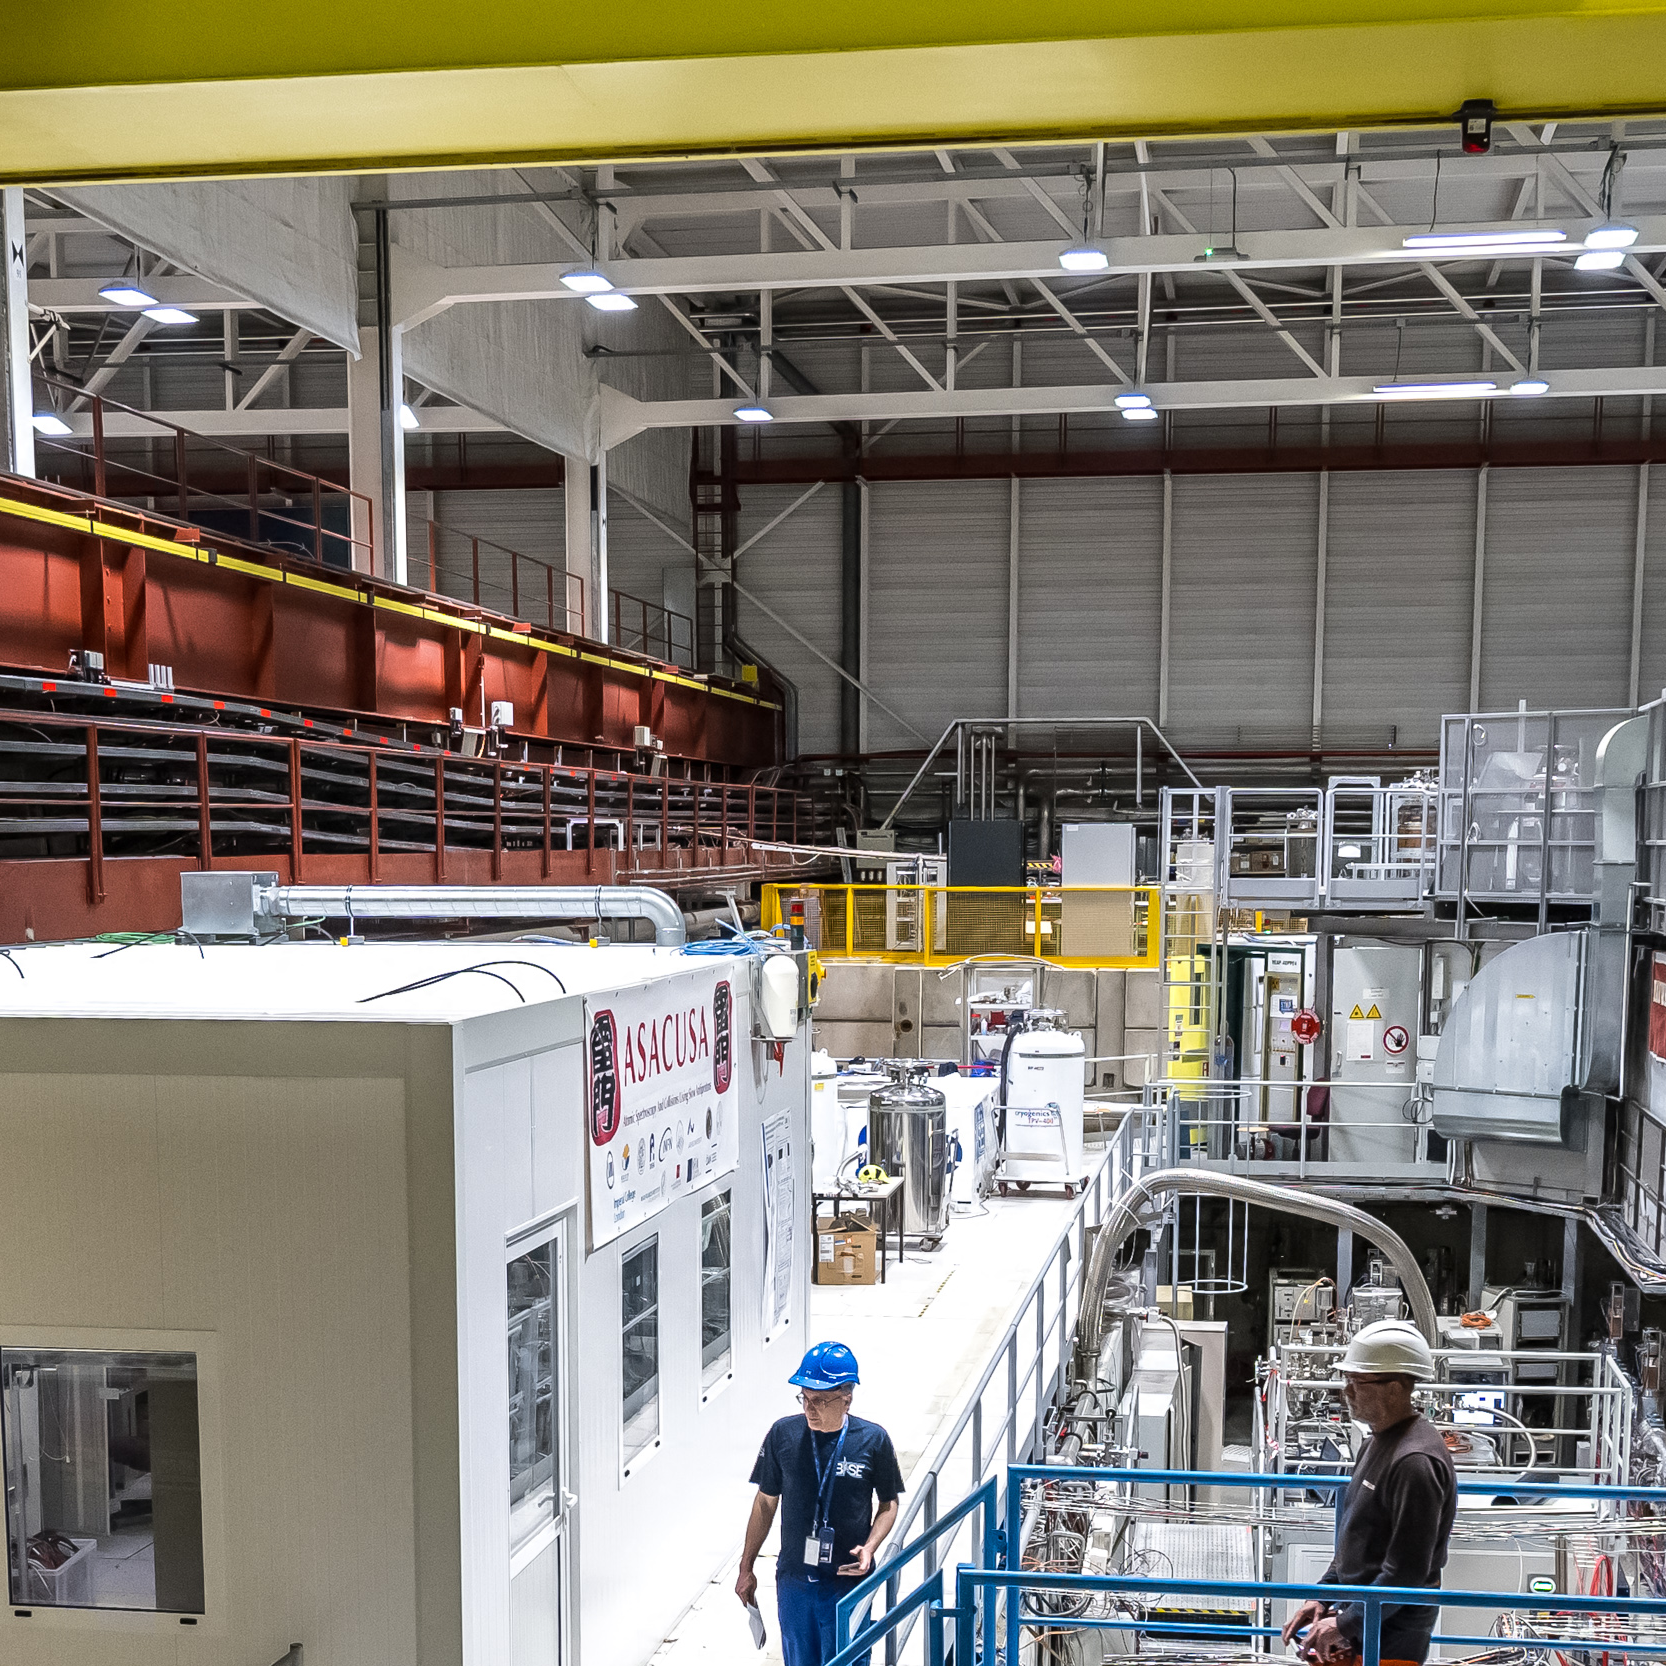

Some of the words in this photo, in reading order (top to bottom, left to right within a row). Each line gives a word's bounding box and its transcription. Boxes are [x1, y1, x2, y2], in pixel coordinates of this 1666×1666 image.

[624, 1005, 709, 1088] ASACUSA
[623, 1113, 635, 1128] Atomic
[635, 1104, 657, 1126] Spectroscopy
